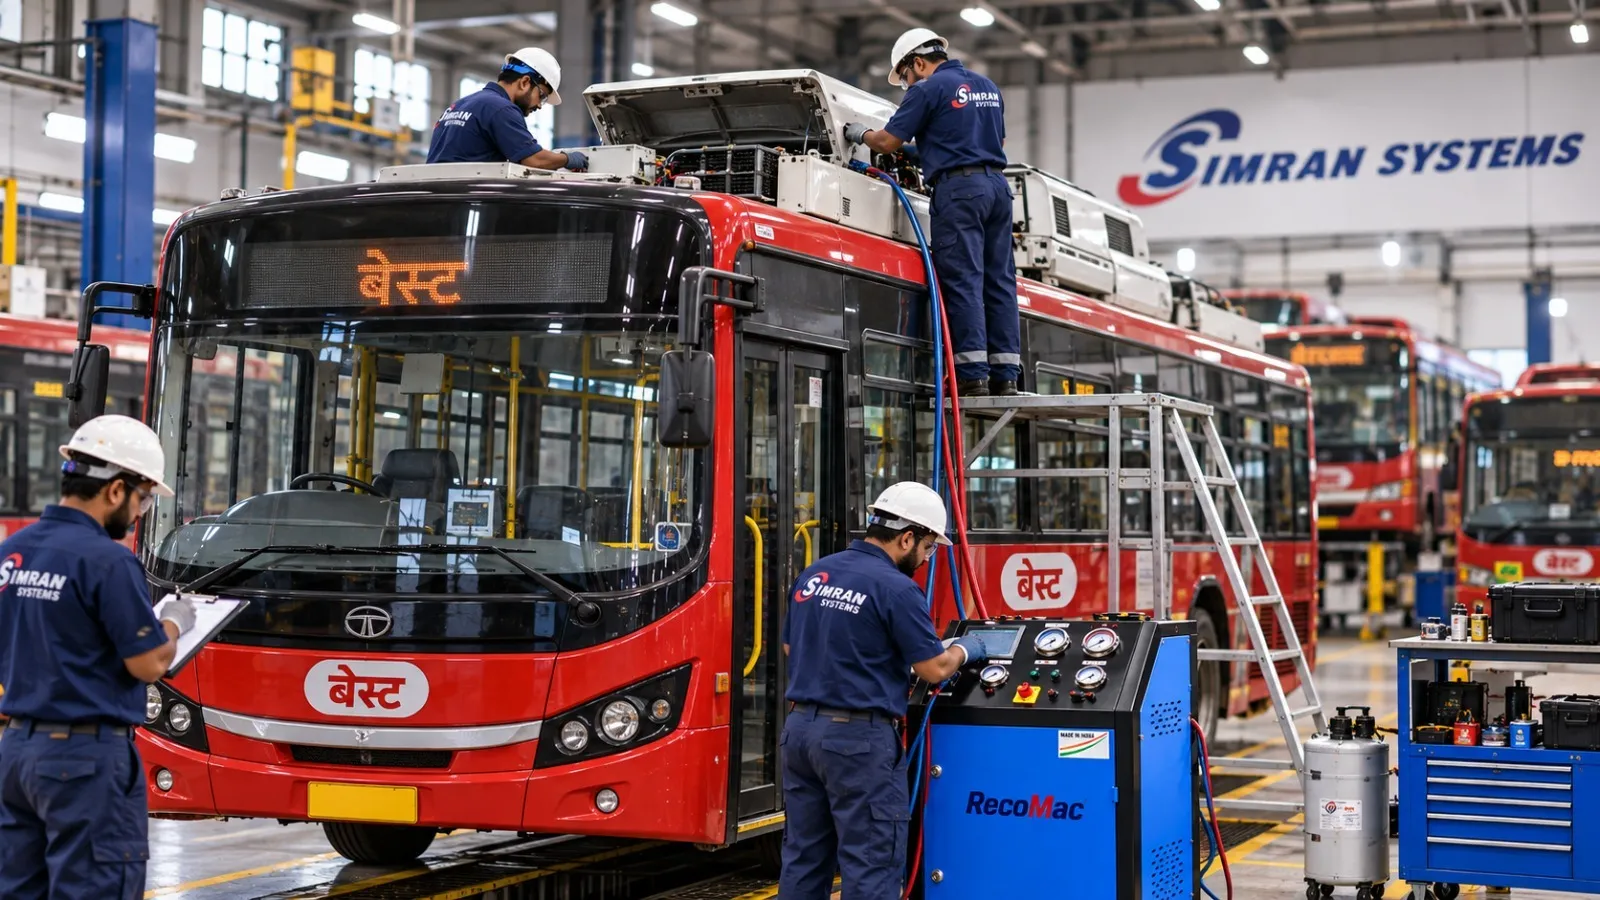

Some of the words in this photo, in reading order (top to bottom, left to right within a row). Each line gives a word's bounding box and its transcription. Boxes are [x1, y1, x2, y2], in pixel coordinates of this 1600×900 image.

[1146, 128, 1367, 189] SIMRAN
[1377, 132, 1586, 176] SYSTEMS
[357, 249, 469, 305] बेस्ट
[0, 560, 67, 590] SIMRAN
[1016, 558, 1063, 601] बेस्ट
[16, 586, 61, 602] SYSTEMS
[802, 576, 867, 606] SIMRAN
[820, 598, 861, 615] SYSTEMS
[328, 664, 406, 710] बेस्ट
[966, 791, 1084, 821] RecoMac
